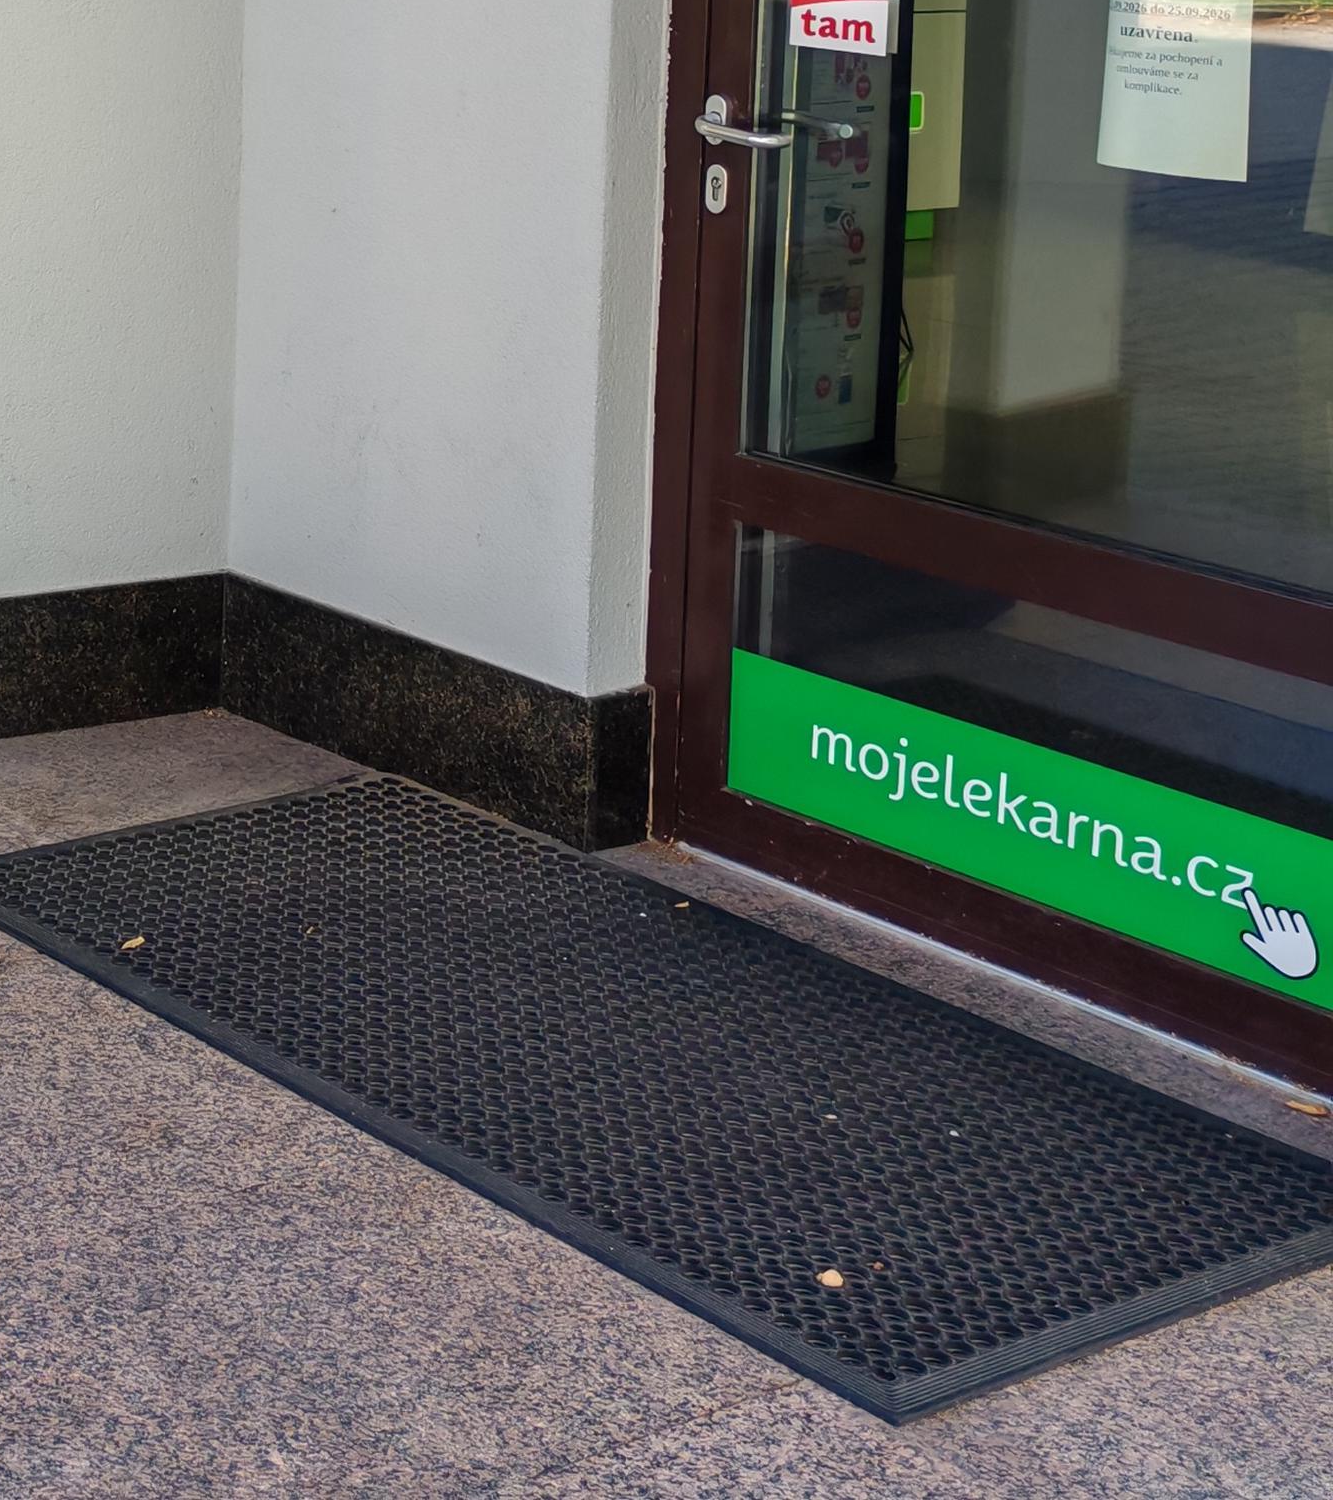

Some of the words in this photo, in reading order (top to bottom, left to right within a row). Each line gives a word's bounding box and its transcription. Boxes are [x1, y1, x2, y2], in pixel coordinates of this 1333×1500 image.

[1150, 2, 1165, 14] do
[1167, 5, 1231, 20] 25.09.2026
[800, 8, 876, 44] tam
[1120, 24, 1199, 43] uzavřena.
[1145, 52, 1157, 61] za
[1159, 52, 1214, 67] pochopení
[1216, 58, 1223, 67] a
[1173, 71, 1184, 79] se
[1187, 72, 1199, 81] za
[1124, 78, 1183, 95] komplikace.
[810, 722, 1254, 909] mojelekarna.cz
